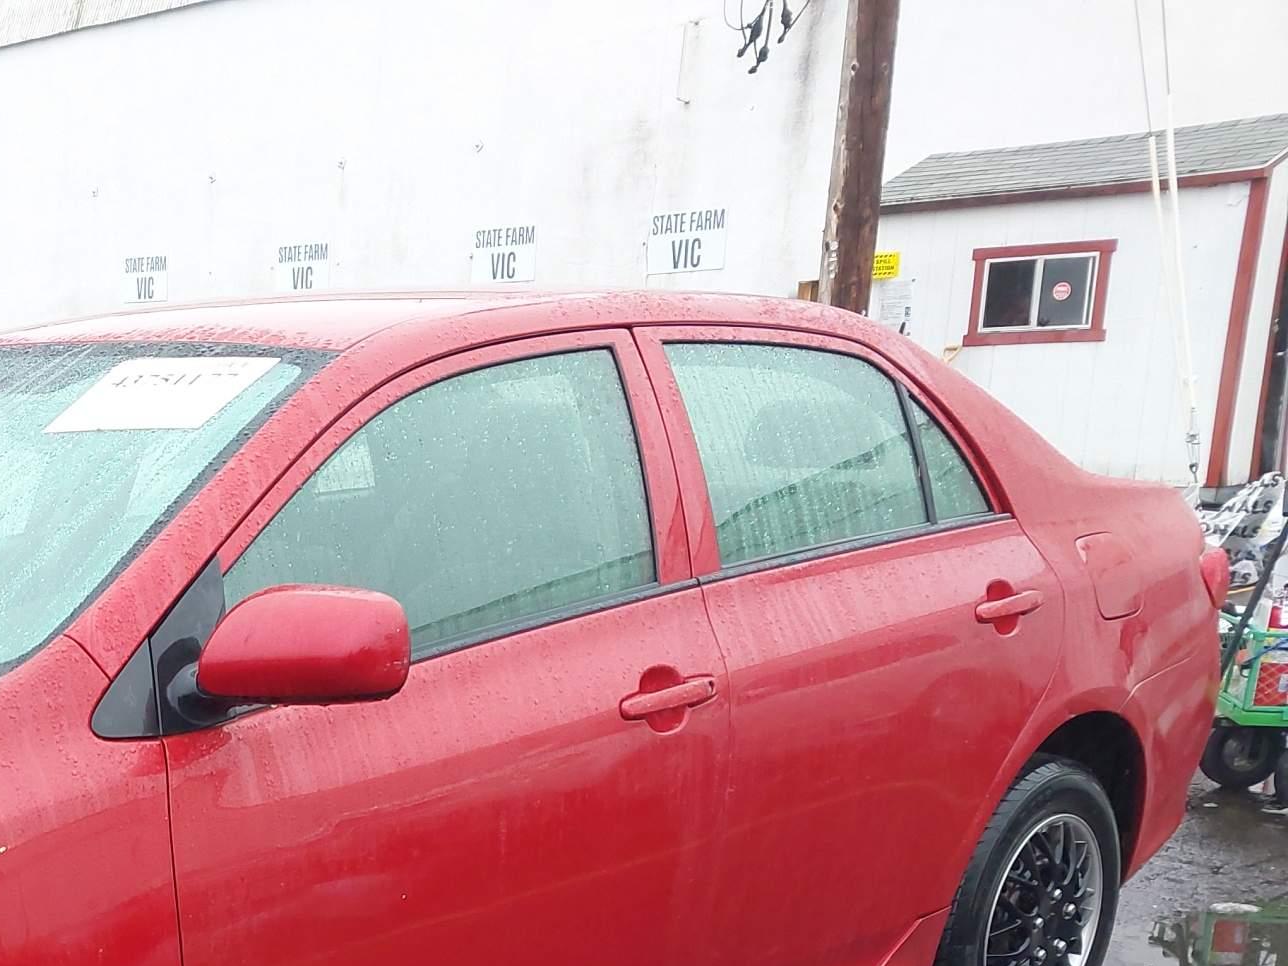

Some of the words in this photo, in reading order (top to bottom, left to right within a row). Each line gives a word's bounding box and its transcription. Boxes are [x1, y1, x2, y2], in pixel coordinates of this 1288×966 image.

[653, 212, 687, 235] STATE
[689, 208, 726, 232] FARM
[475, 228, 503, 248] STATE
[505, 225, 535, 246] FARM
[125, 257, 145, 273] STATE
[146, 256, 167, 272] FARM
[278, 246, 302, 263] STATE
[304, 243, 328, 261] FARM
[671, 238, 702, 269] VIC
[491, 251, 516, 279] VIC
[136, 276, 154, 299] VIC
[292, 266, 313, 289] VIC
